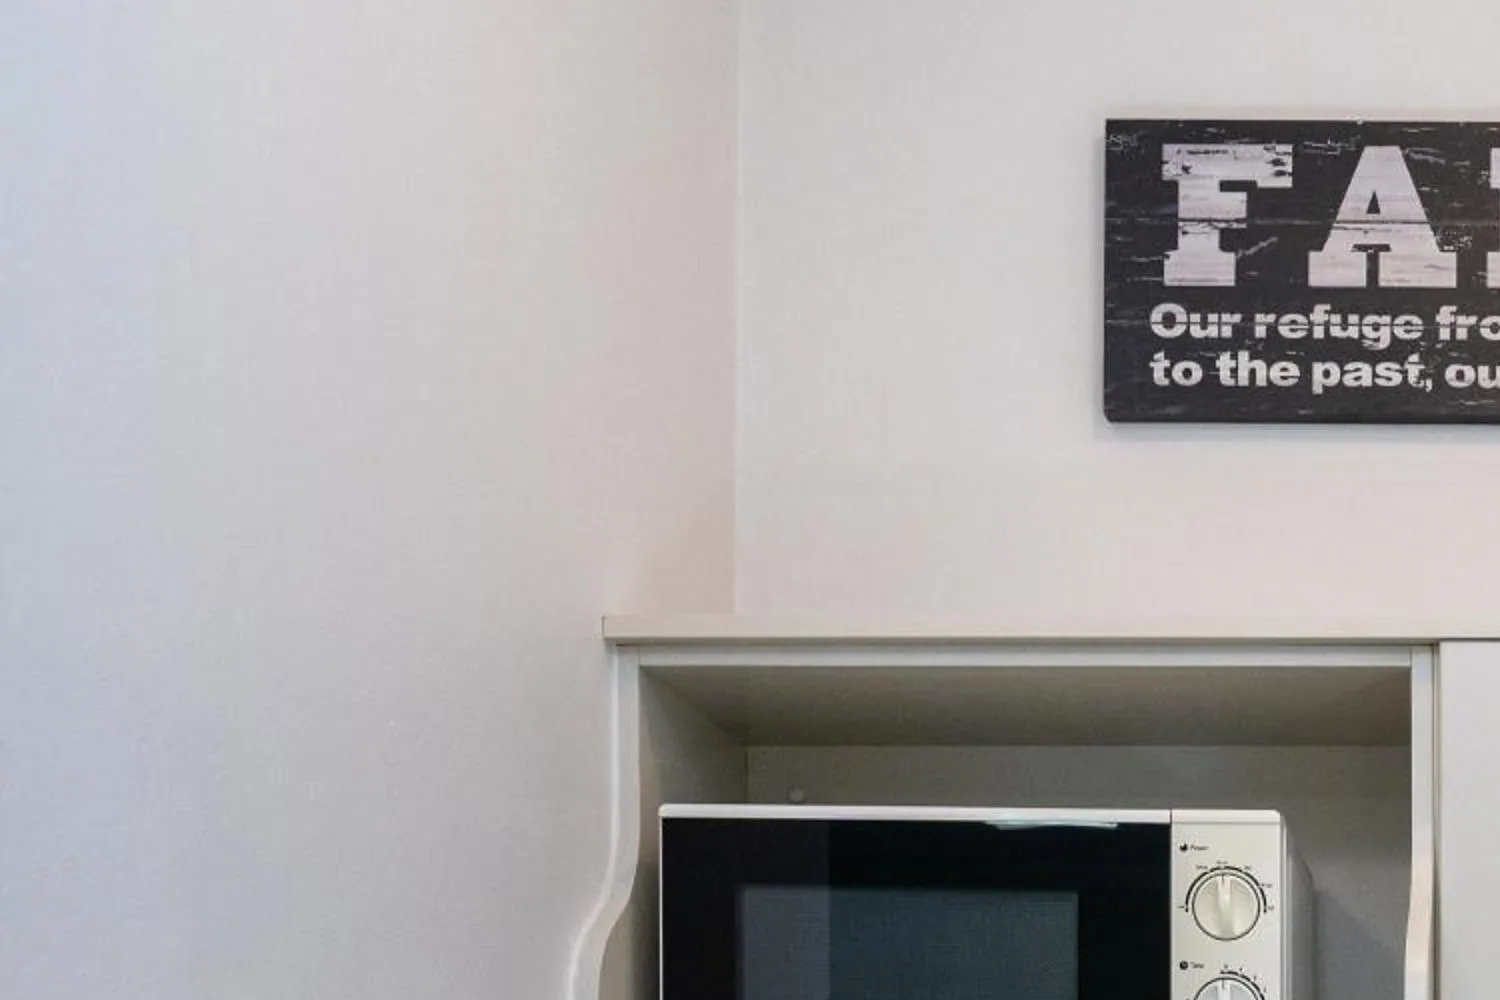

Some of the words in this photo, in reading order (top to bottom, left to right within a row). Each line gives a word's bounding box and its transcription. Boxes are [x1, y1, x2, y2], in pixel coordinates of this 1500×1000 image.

[1149, 302, 1243, 340] Our
[1254, 303, 1425, 351] refuge
[1149, 351, 1203, 387] to
[1215, 350, 1300, 388] the
[1311, 353, 1434, 395] past,
